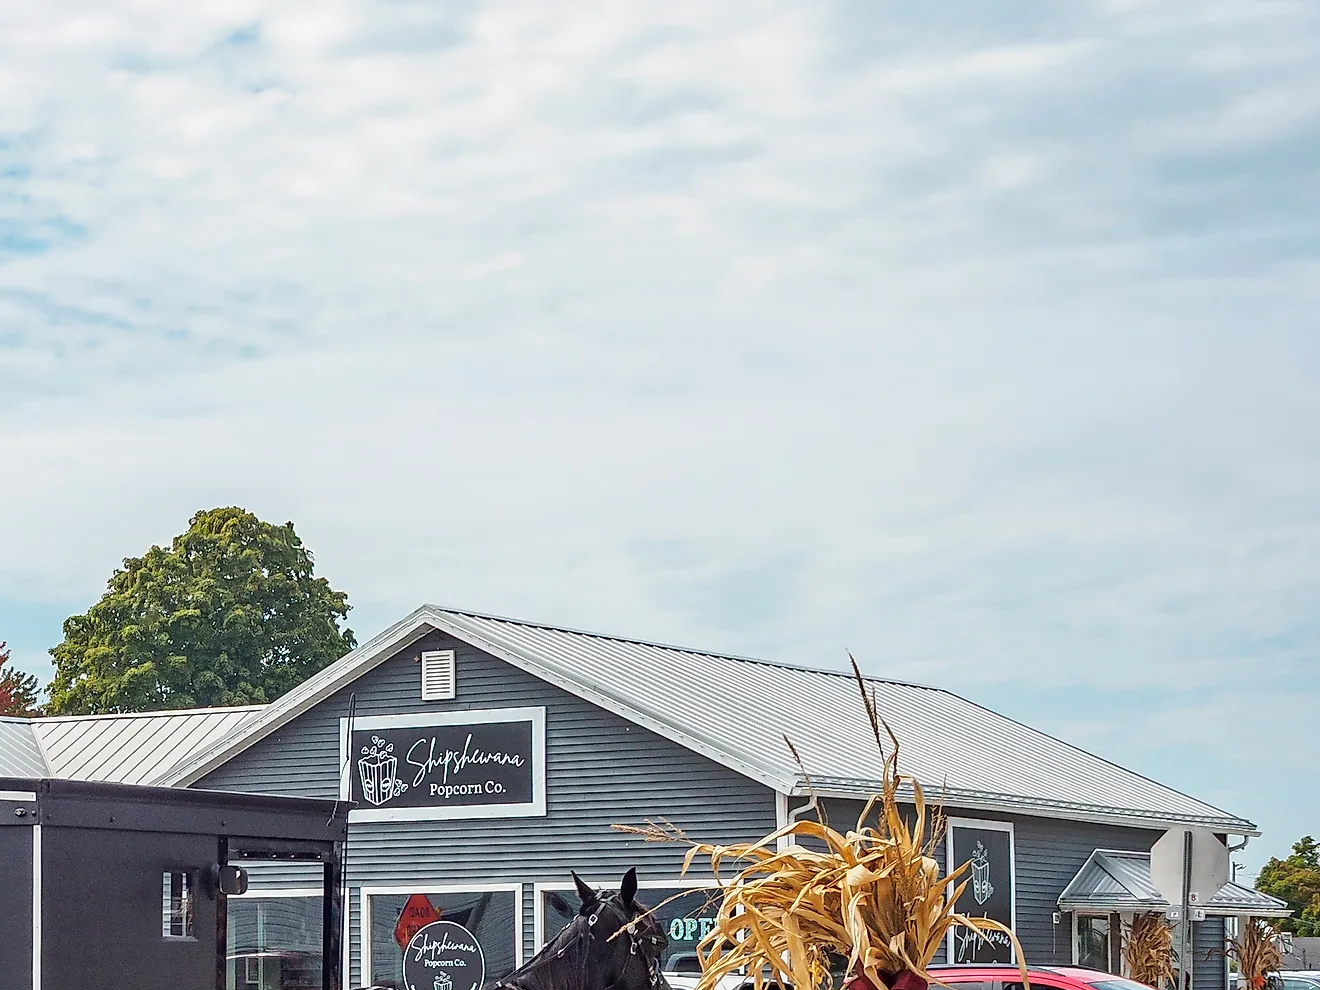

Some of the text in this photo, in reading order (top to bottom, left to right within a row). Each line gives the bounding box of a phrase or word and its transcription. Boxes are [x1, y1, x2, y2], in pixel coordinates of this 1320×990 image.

[406, 733, 525, 787] Shipshewana
[429, 781, 507, 798] Popcorn Co.
[670, 917, 720, 940] OPE
[411, 932, 477, 962] Shipshewana
[424, 958, 467, 968] Popcorn Co.
